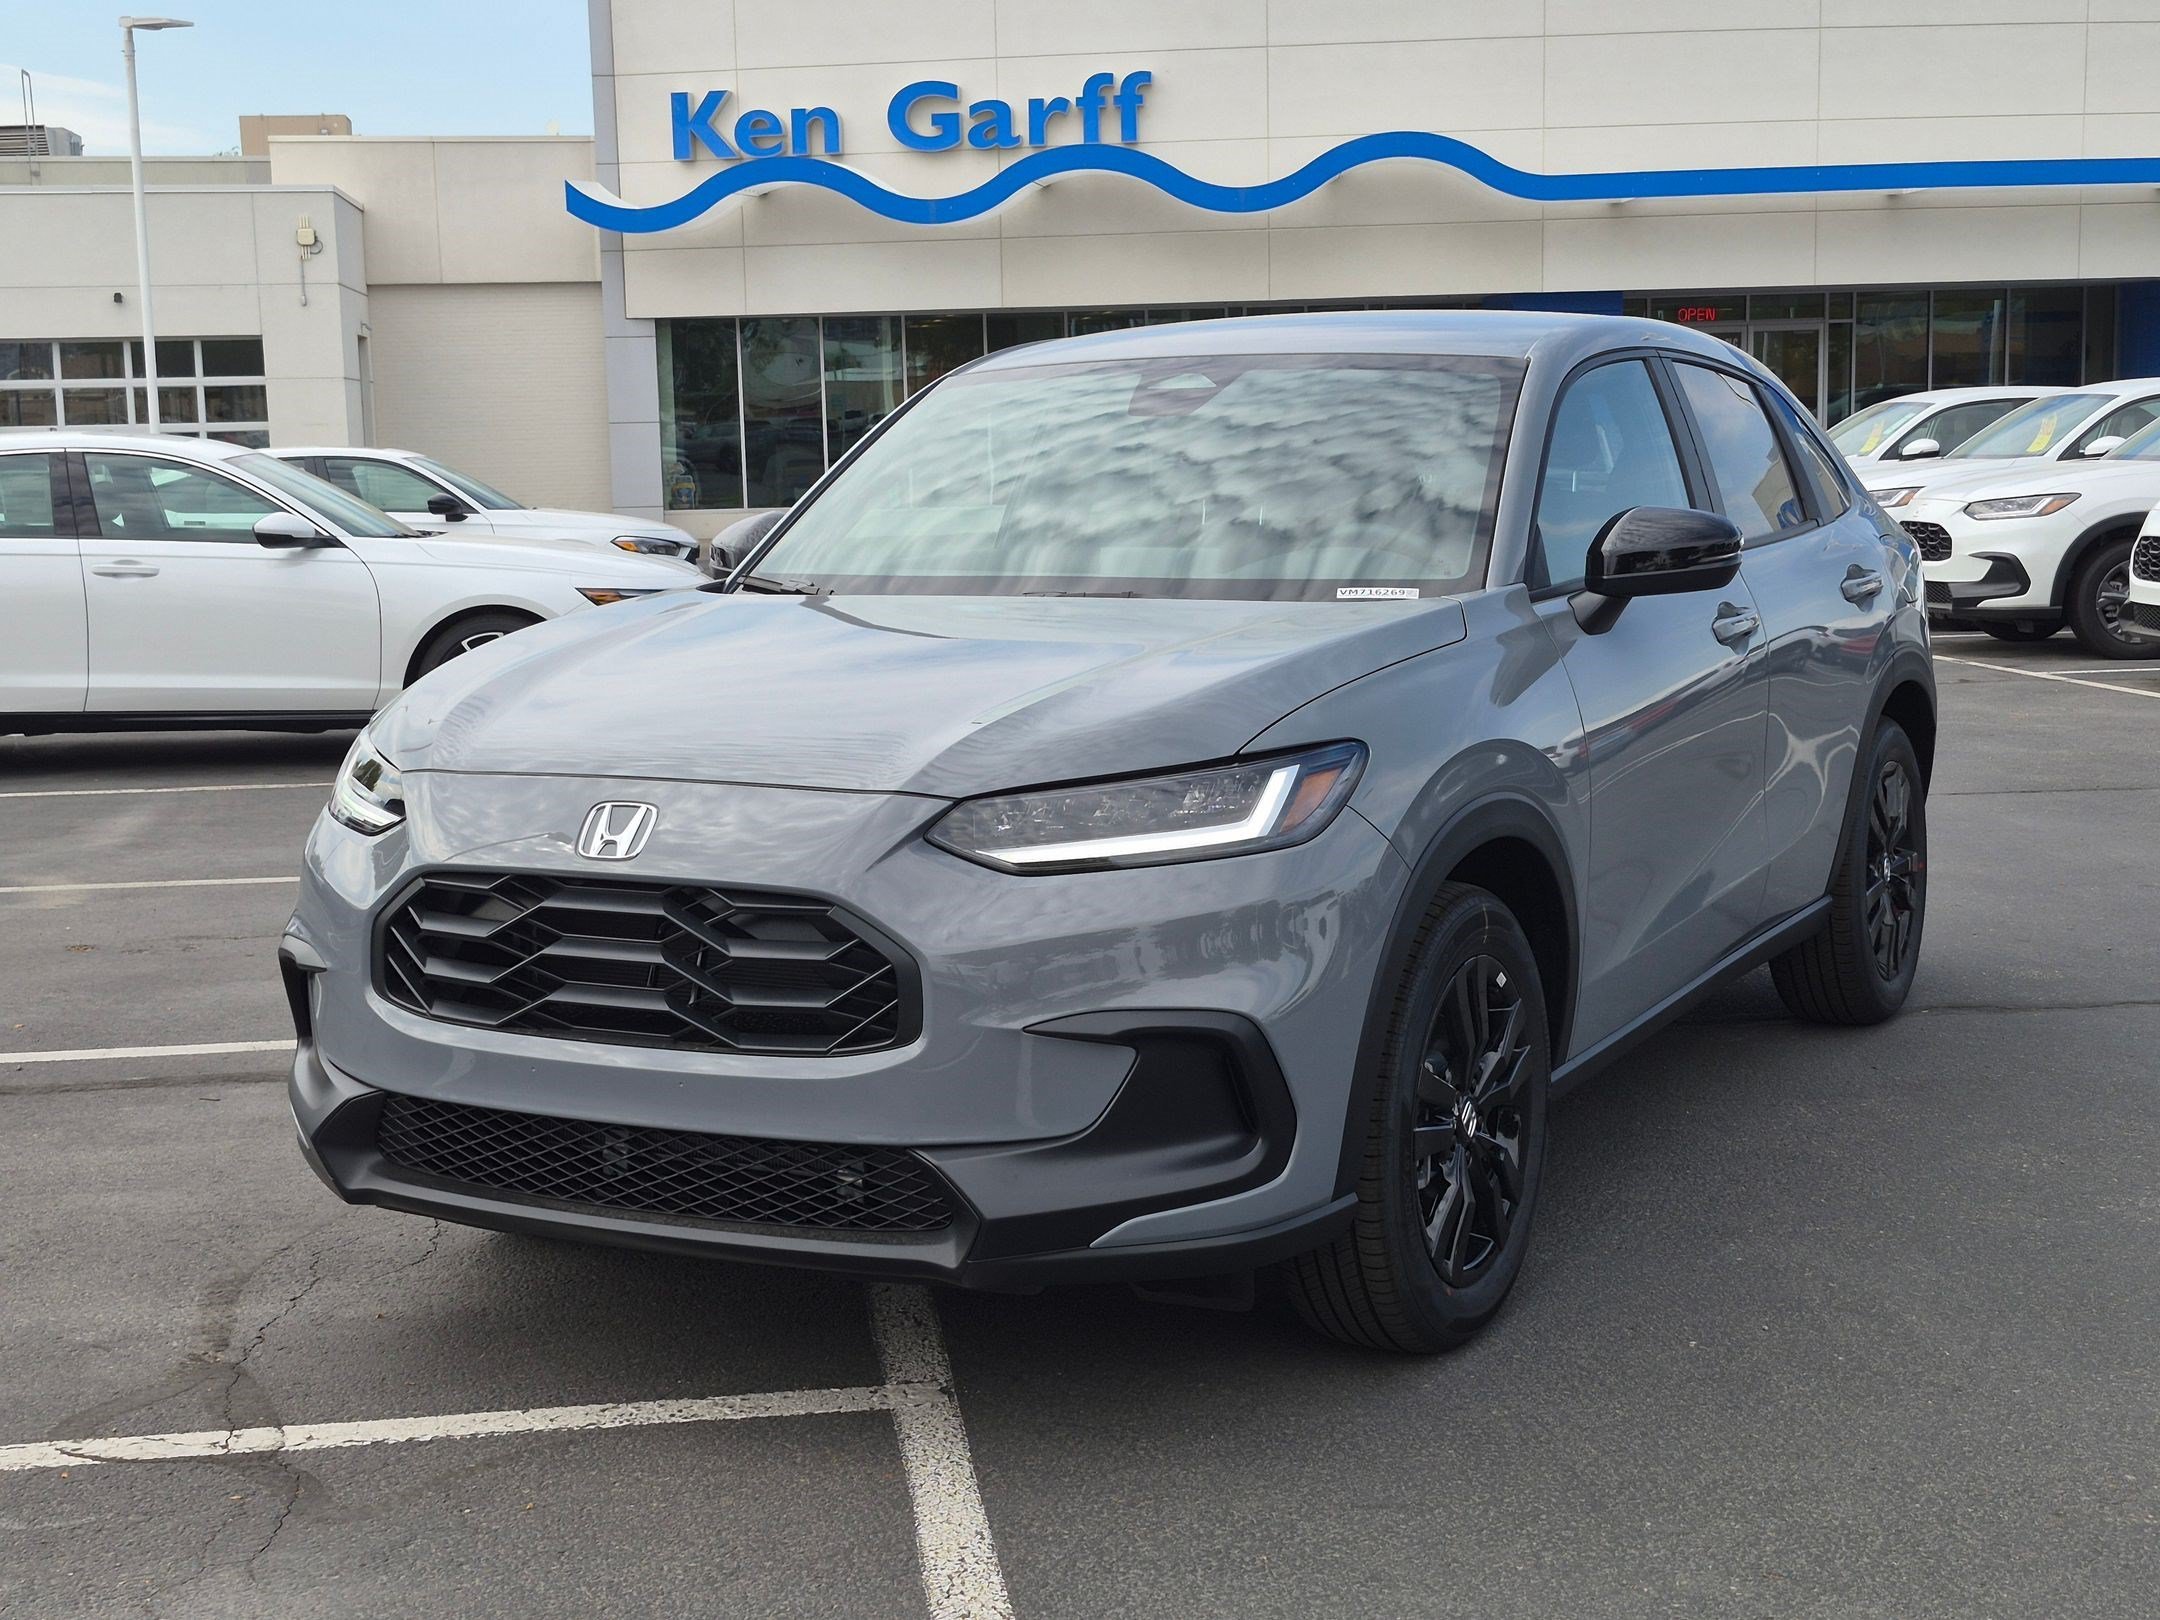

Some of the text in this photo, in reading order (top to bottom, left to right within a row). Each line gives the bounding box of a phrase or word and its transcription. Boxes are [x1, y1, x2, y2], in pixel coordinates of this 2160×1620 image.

[670, 70, 1153, 161] Ken Garff
[1678, 307, 1716, 321] OPEN
[1339, 588, 1406, 597] VM716269
